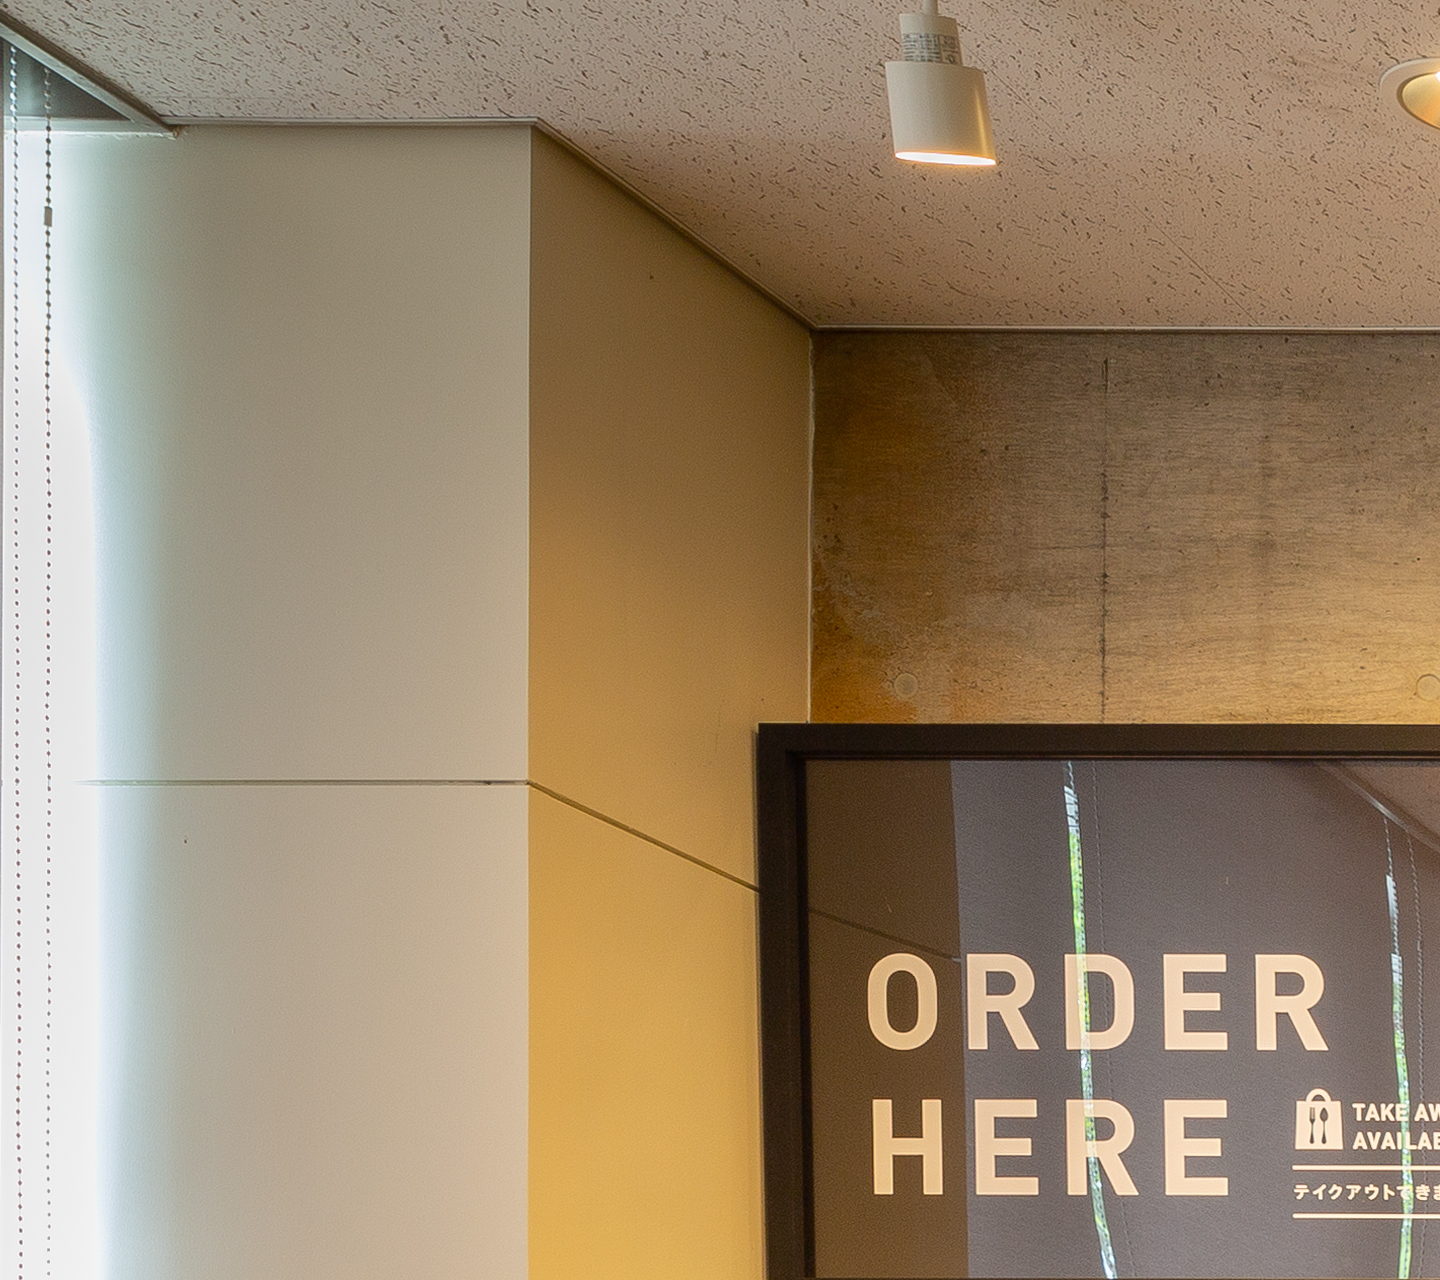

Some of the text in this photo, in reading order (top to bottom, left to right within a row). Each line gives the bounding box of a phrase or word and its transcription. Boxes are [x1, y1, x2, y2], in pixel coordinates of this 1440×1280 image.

[867, 953, 1328, 1051] ORDER
[871, 1099, 1229, 1196] HERE
[1353, 1103, 1408, 1122] TAKE
